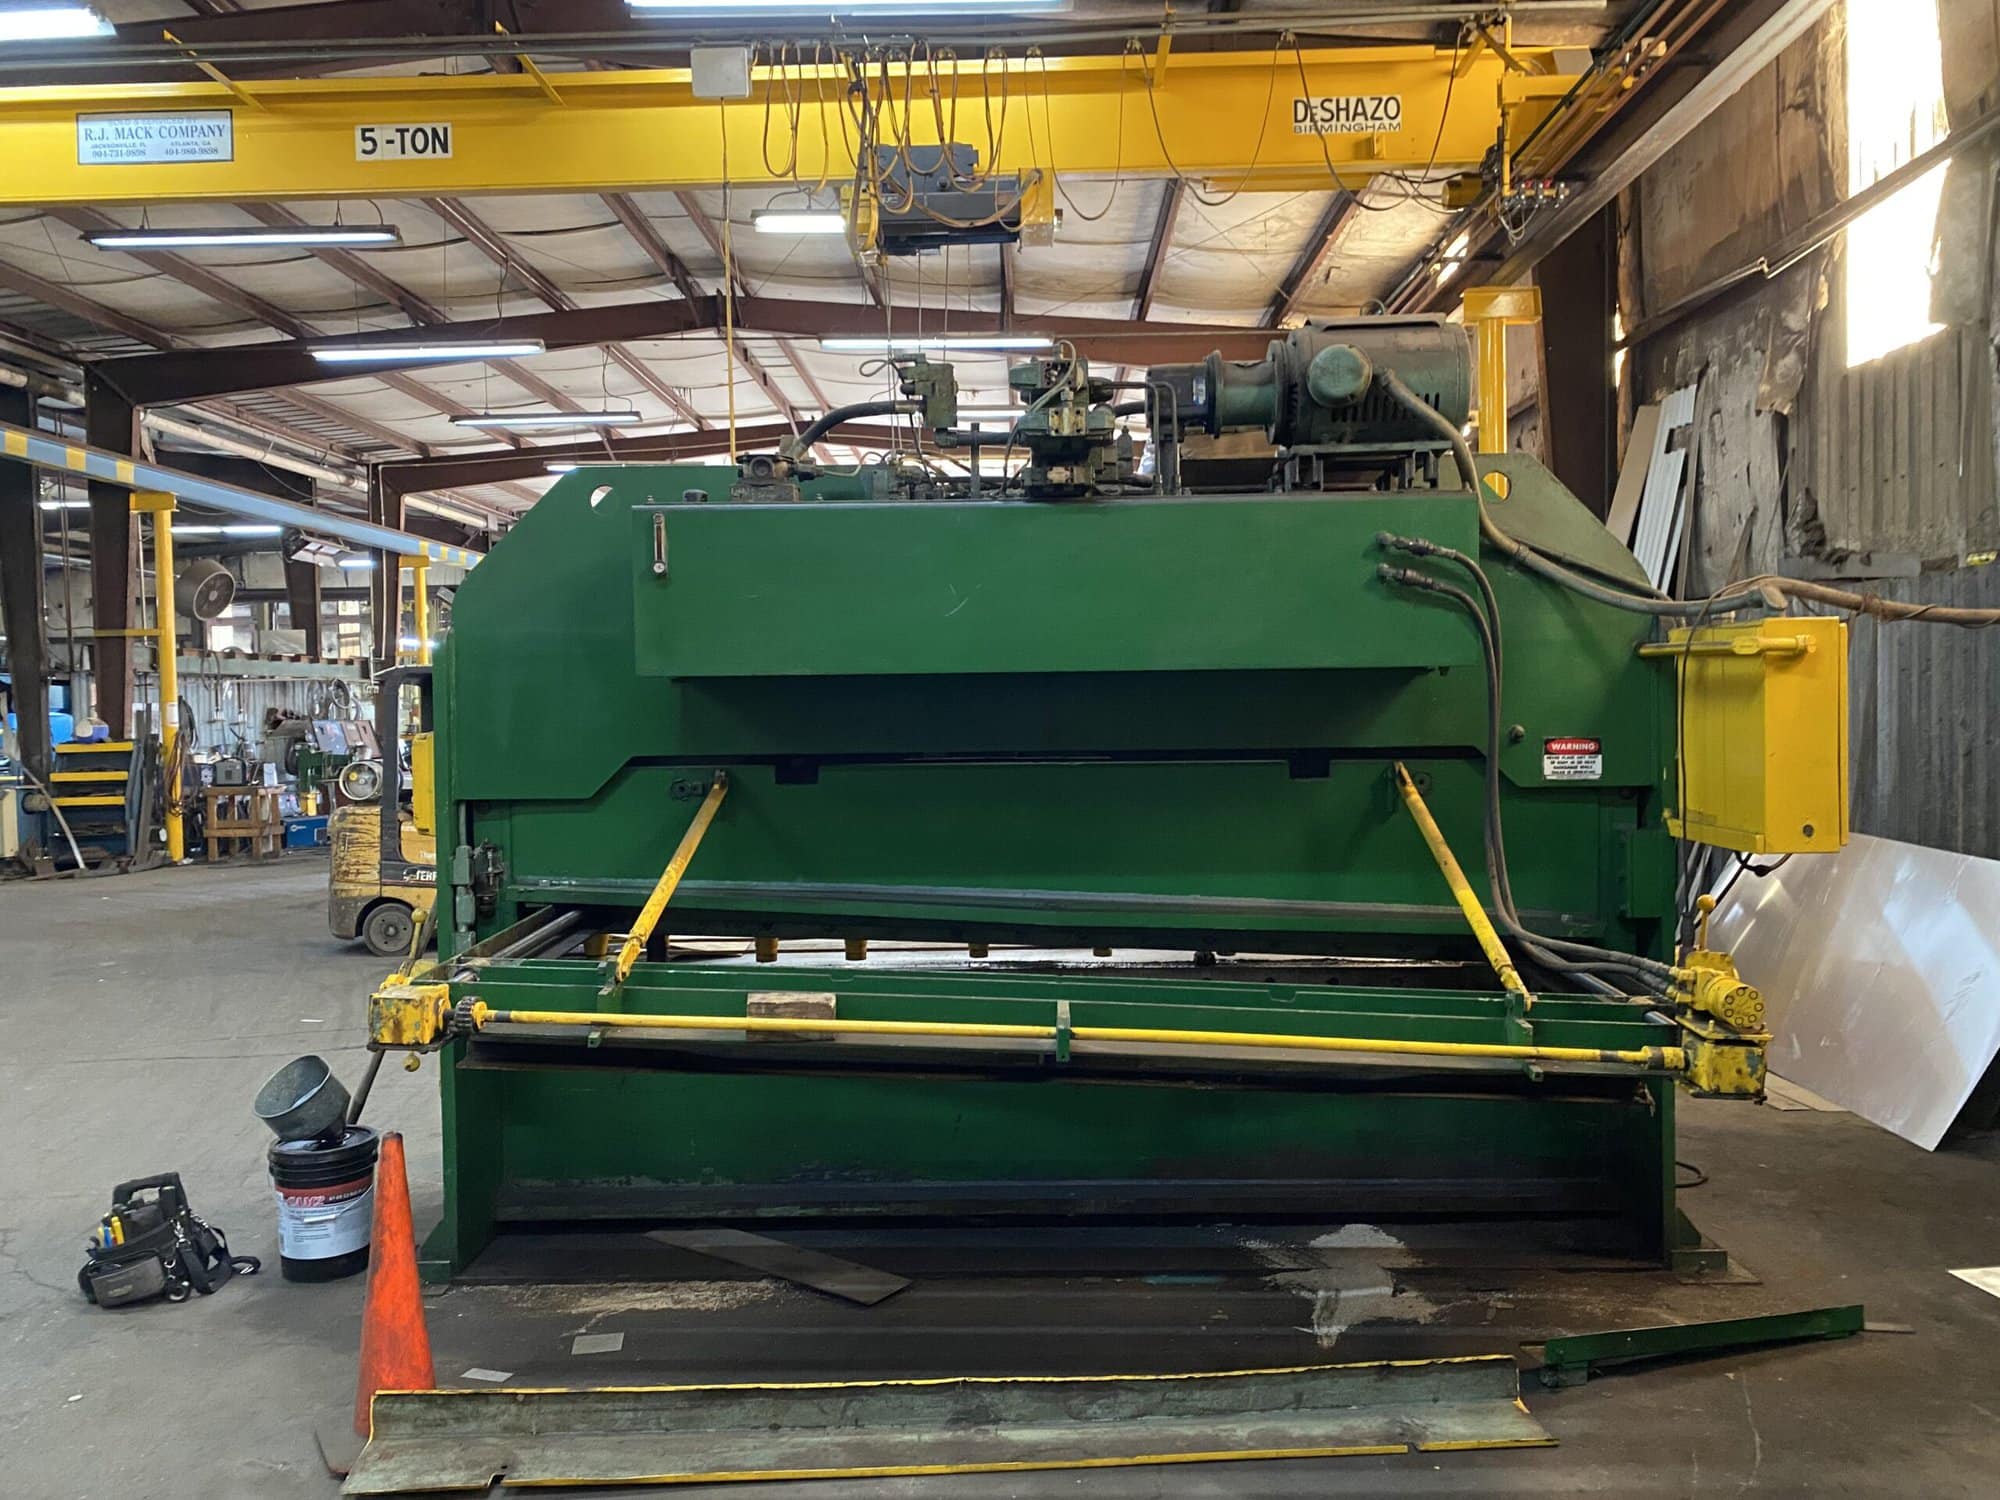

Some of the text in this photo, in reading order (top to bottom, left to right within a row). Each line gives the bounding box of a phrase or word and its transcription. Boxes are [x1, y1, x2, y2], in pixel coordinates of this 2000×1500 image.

[84, 124, 226, 141] R.J. MACK COMPANY
[1293, 122, 1401, 134] BIRMINGHAM
[1551, 742, 1596, 751] WARNING
